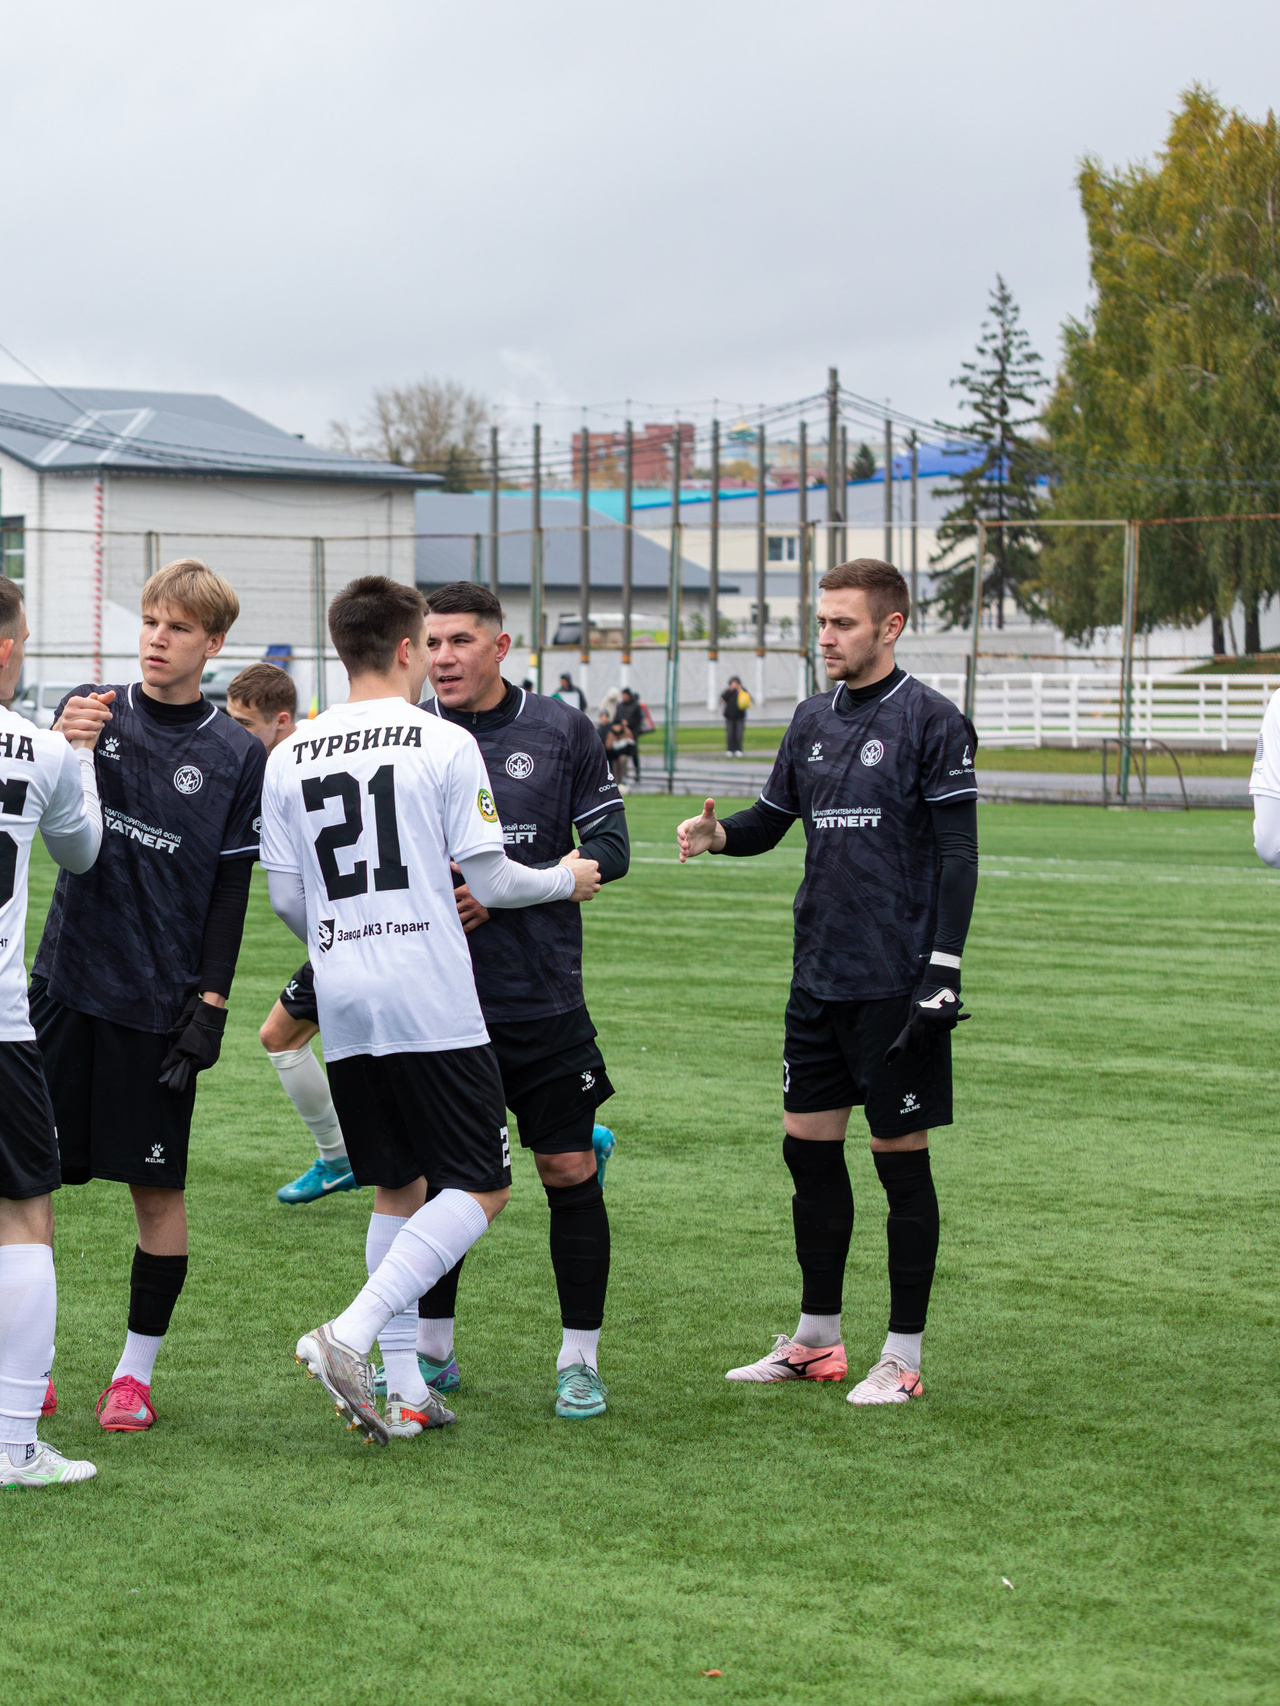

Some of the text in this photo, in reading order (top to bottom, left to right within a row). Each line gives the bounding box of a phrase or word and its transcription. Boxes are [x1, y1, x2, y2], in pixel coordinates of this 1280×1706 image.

[292, 726, 422, 764] ТУРБИНА
[98, 749, 120, 760] KELME
[863, 807, 882, 815] ФОНД
[813, 815, 882, 829] TATNEFT
[104, 813, 180, 854] TATNEFT
[163, 831, 182, 843] ФОНД
[301, 764, 410, 902] 21
[337, 922, 430, 942] Завод АКЗ Гарант
[900, 1103, 921, 1114] KELME
